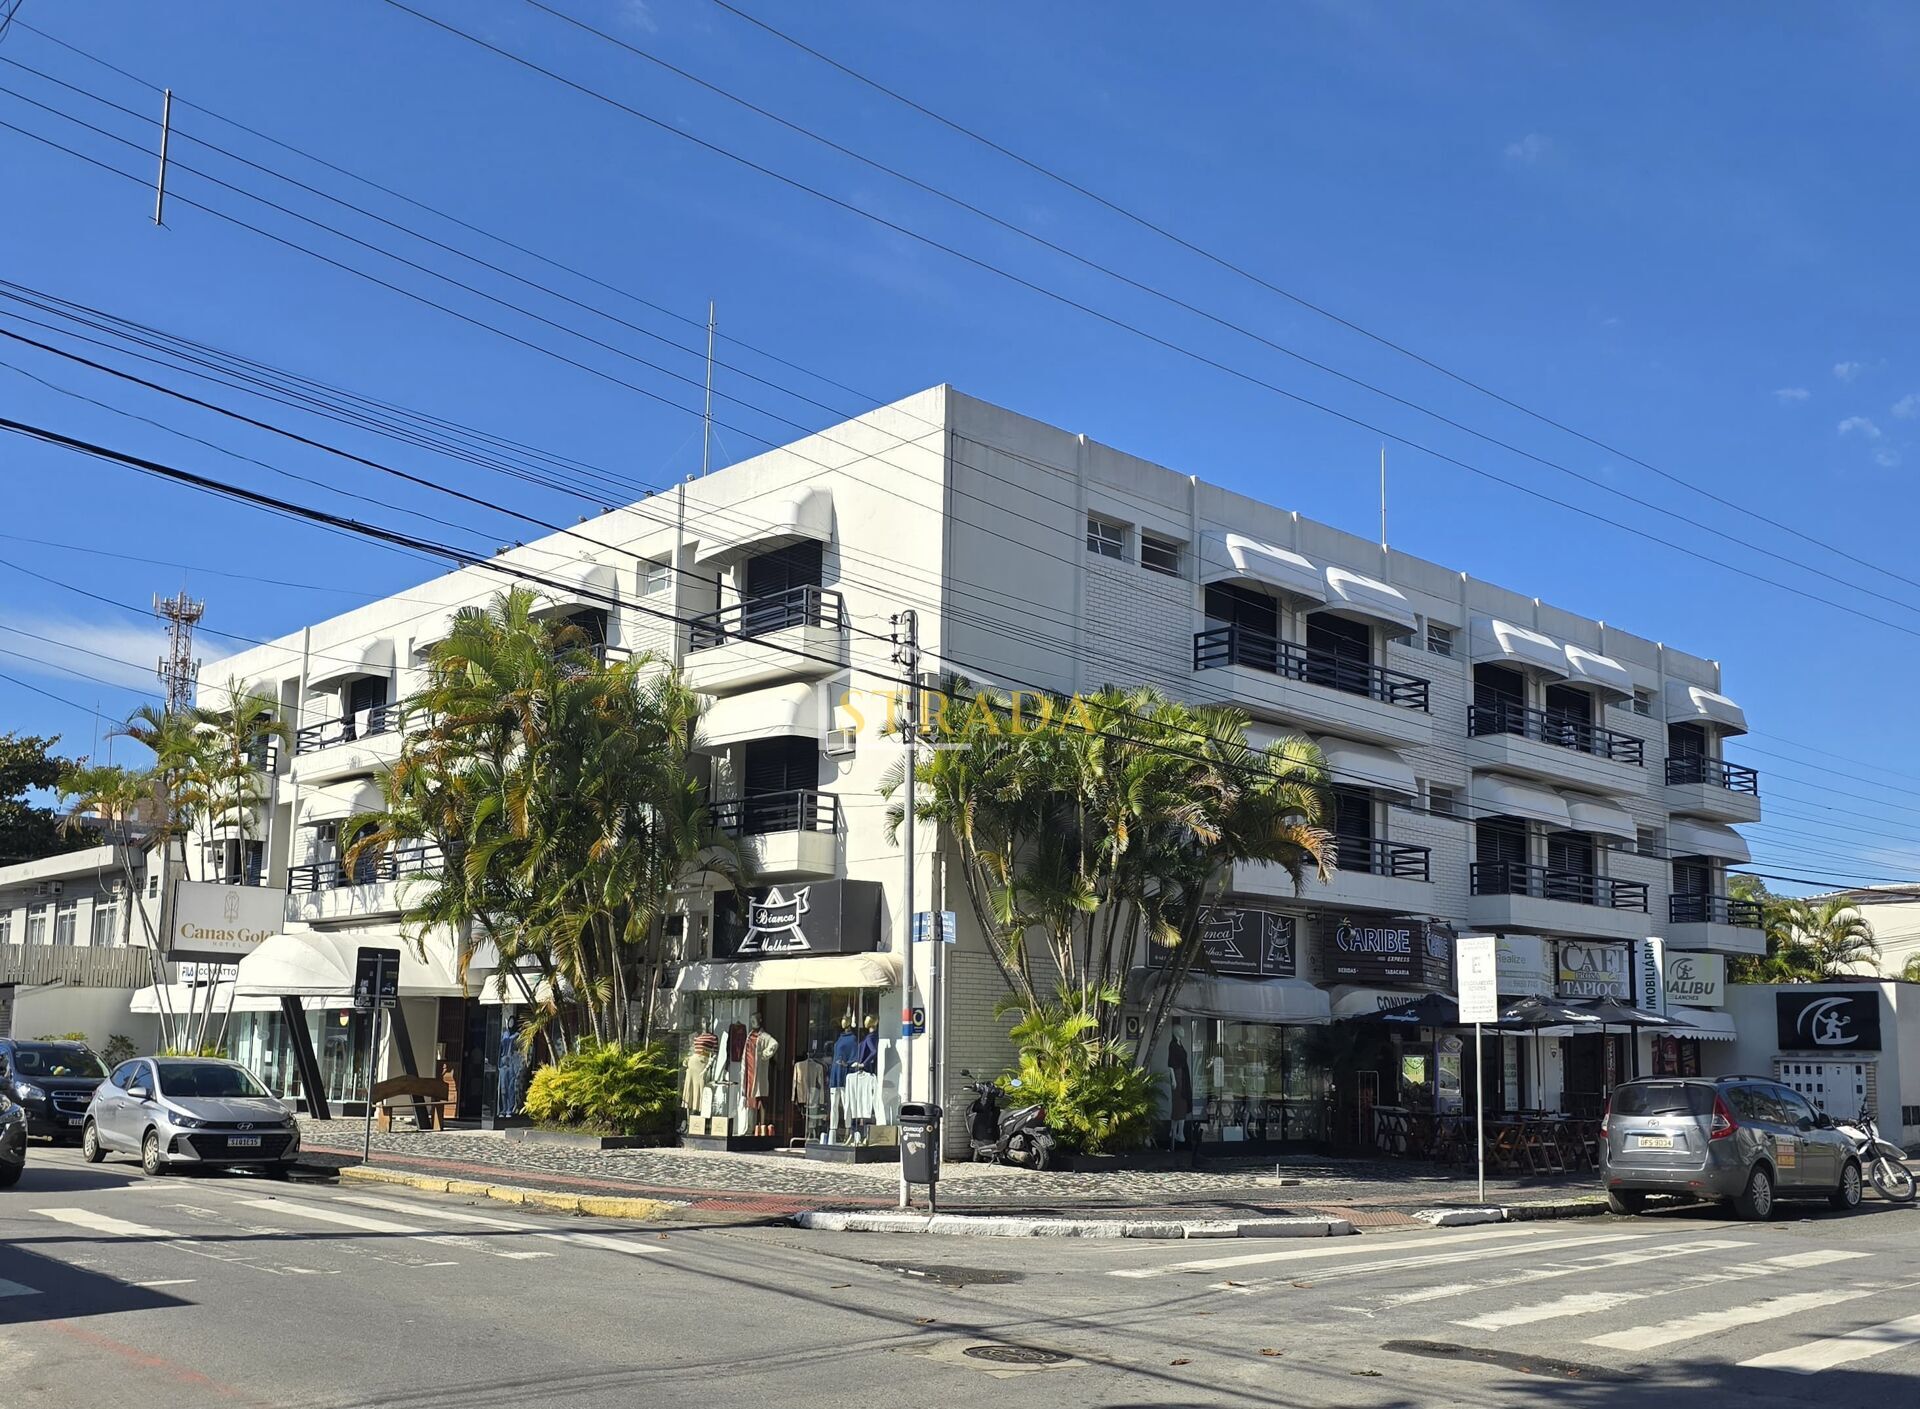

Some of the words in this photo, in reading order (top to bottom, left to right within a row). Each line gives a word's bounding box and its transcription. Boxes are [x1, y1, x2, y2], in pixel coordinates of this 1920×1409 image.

[756, 909, 796, 925] Bianca
[181, 923, 234, 942] Canas
[1336, 926, 1410, 953] CARIBE
[198, 967, 237, 977] COATTO
[1642, 941, 1656, 1009] IMOBILIÁRIA
[1562, 980, 1628, 998] TAPIOCA
